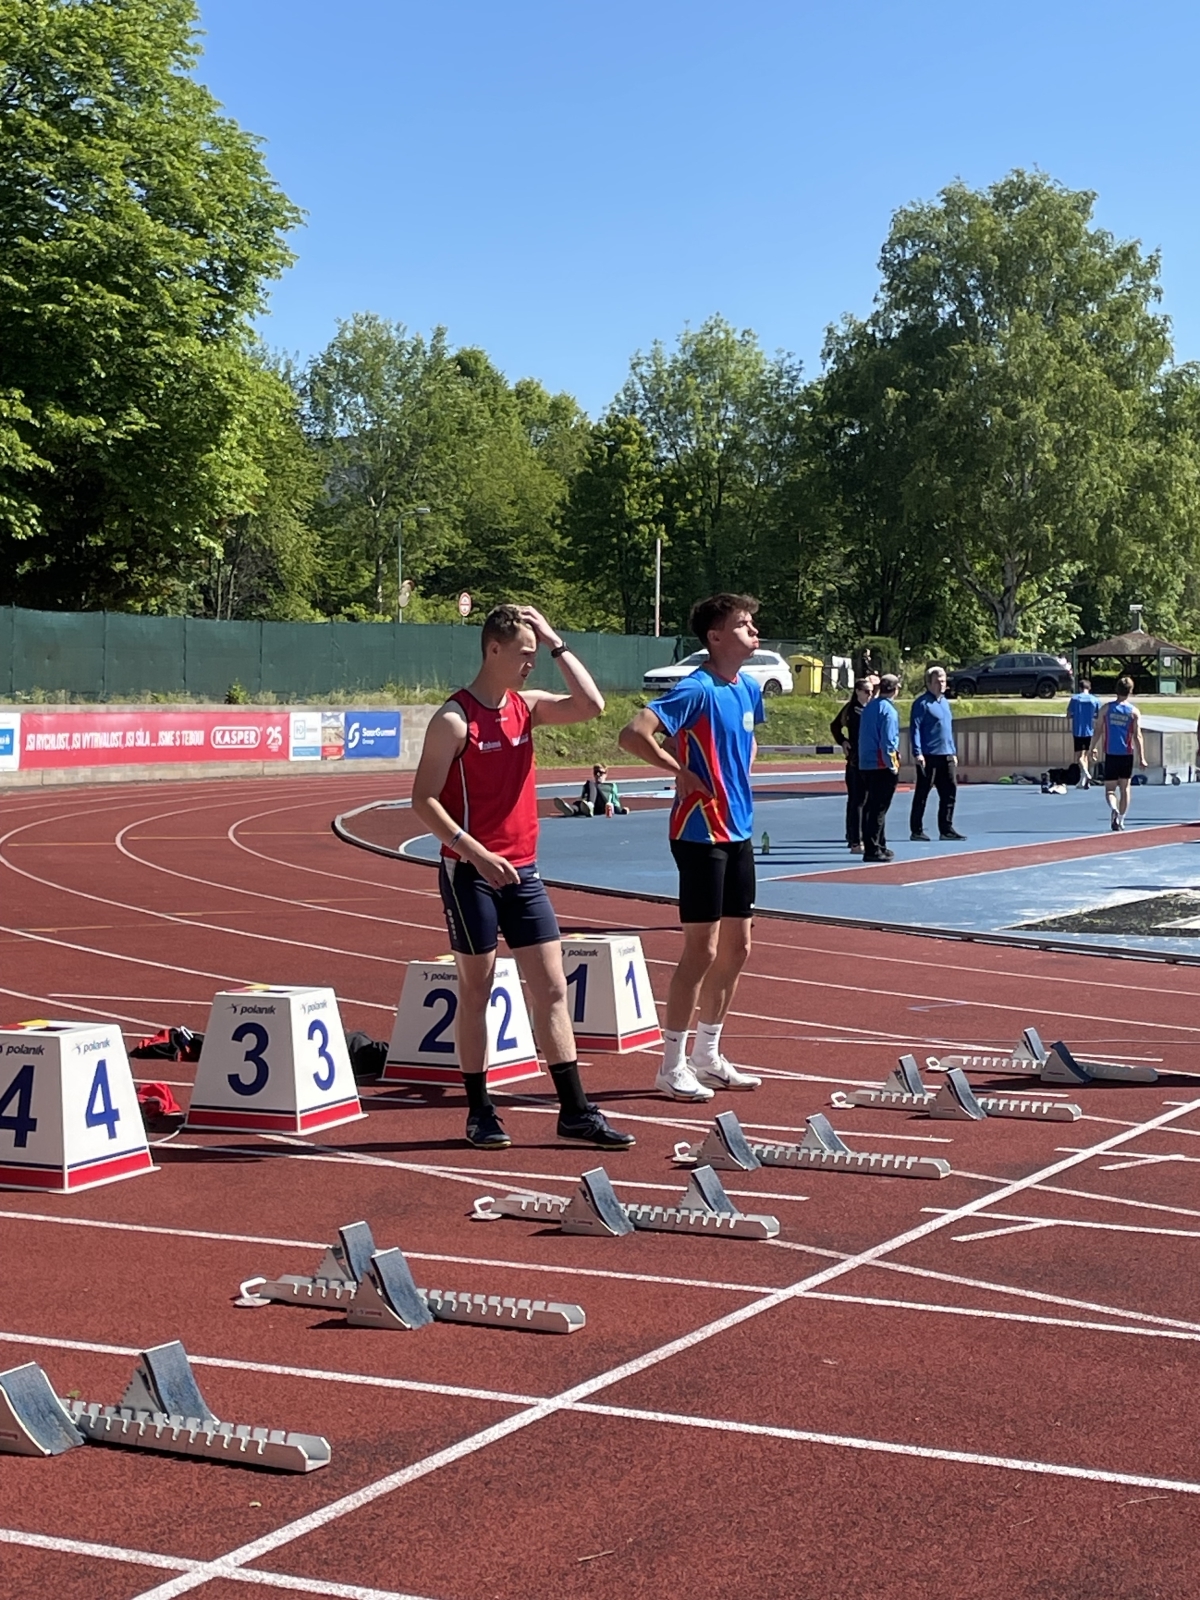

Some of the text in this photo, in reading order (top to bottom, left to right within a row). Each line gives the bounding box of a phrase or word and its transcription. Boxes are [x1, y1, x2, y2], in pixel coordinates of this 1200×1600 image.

[215, 730, 257, 744] KASPER
[266, 726, 283, 746] 25
[568, 948, 599, 957] polanik
[240, 1004, 277, 1016] polanik
[490, 986, 518, 1052] 2
[567, 963, 588, 1023] 1
[625, 960, 642, 1019] 1
[6, 1044, 45, 1056] polanik
[83, 1038, 110, 1054] polanik
[418, 988, 458, 1054] 2
[227, 1022, 269, 1096] 3
[307, 1019, 335, 1091] 3
[0, 1065, 37, 1147] 4
[85, 1058, 120, 1140] 4
